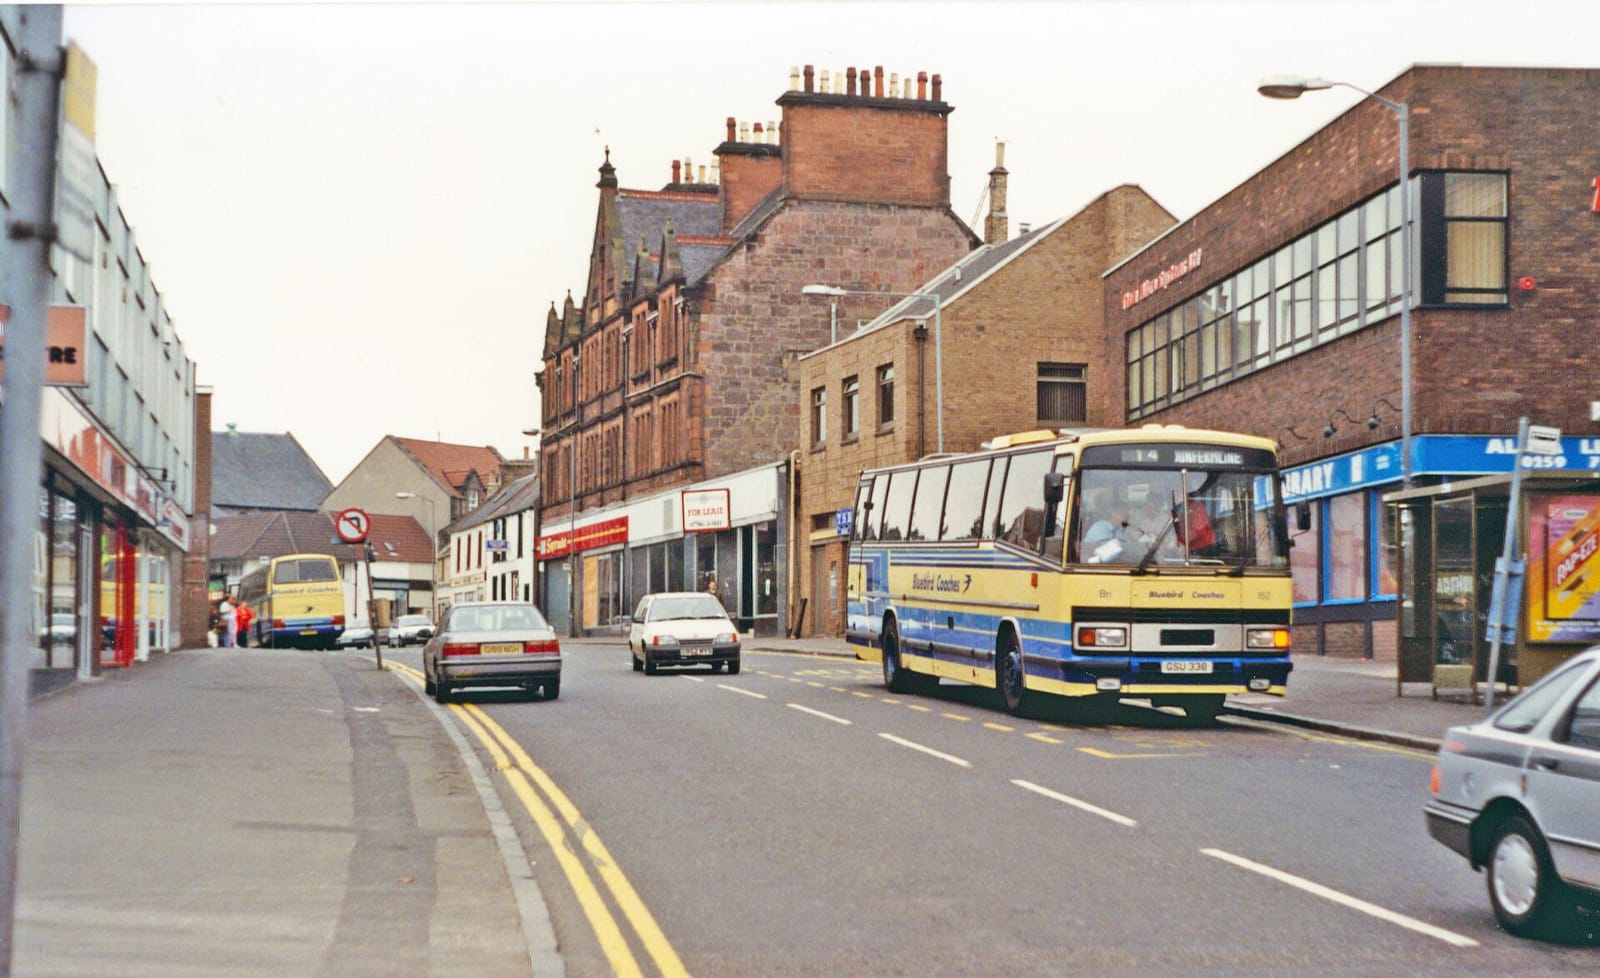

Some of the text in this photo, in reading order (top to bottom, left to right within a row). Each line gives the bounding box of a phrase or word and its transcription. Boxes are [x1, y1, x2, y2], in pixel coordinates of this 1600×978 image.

[1522, 455, 1567, 468] 0259
[688, 506, 724, 517] FOR LEASE
[912, 571, 960, 592] Bluebird Coaches
[1191, 591, 1225, 599] Coaches
[1166, 662, 1186, 671] GSU
